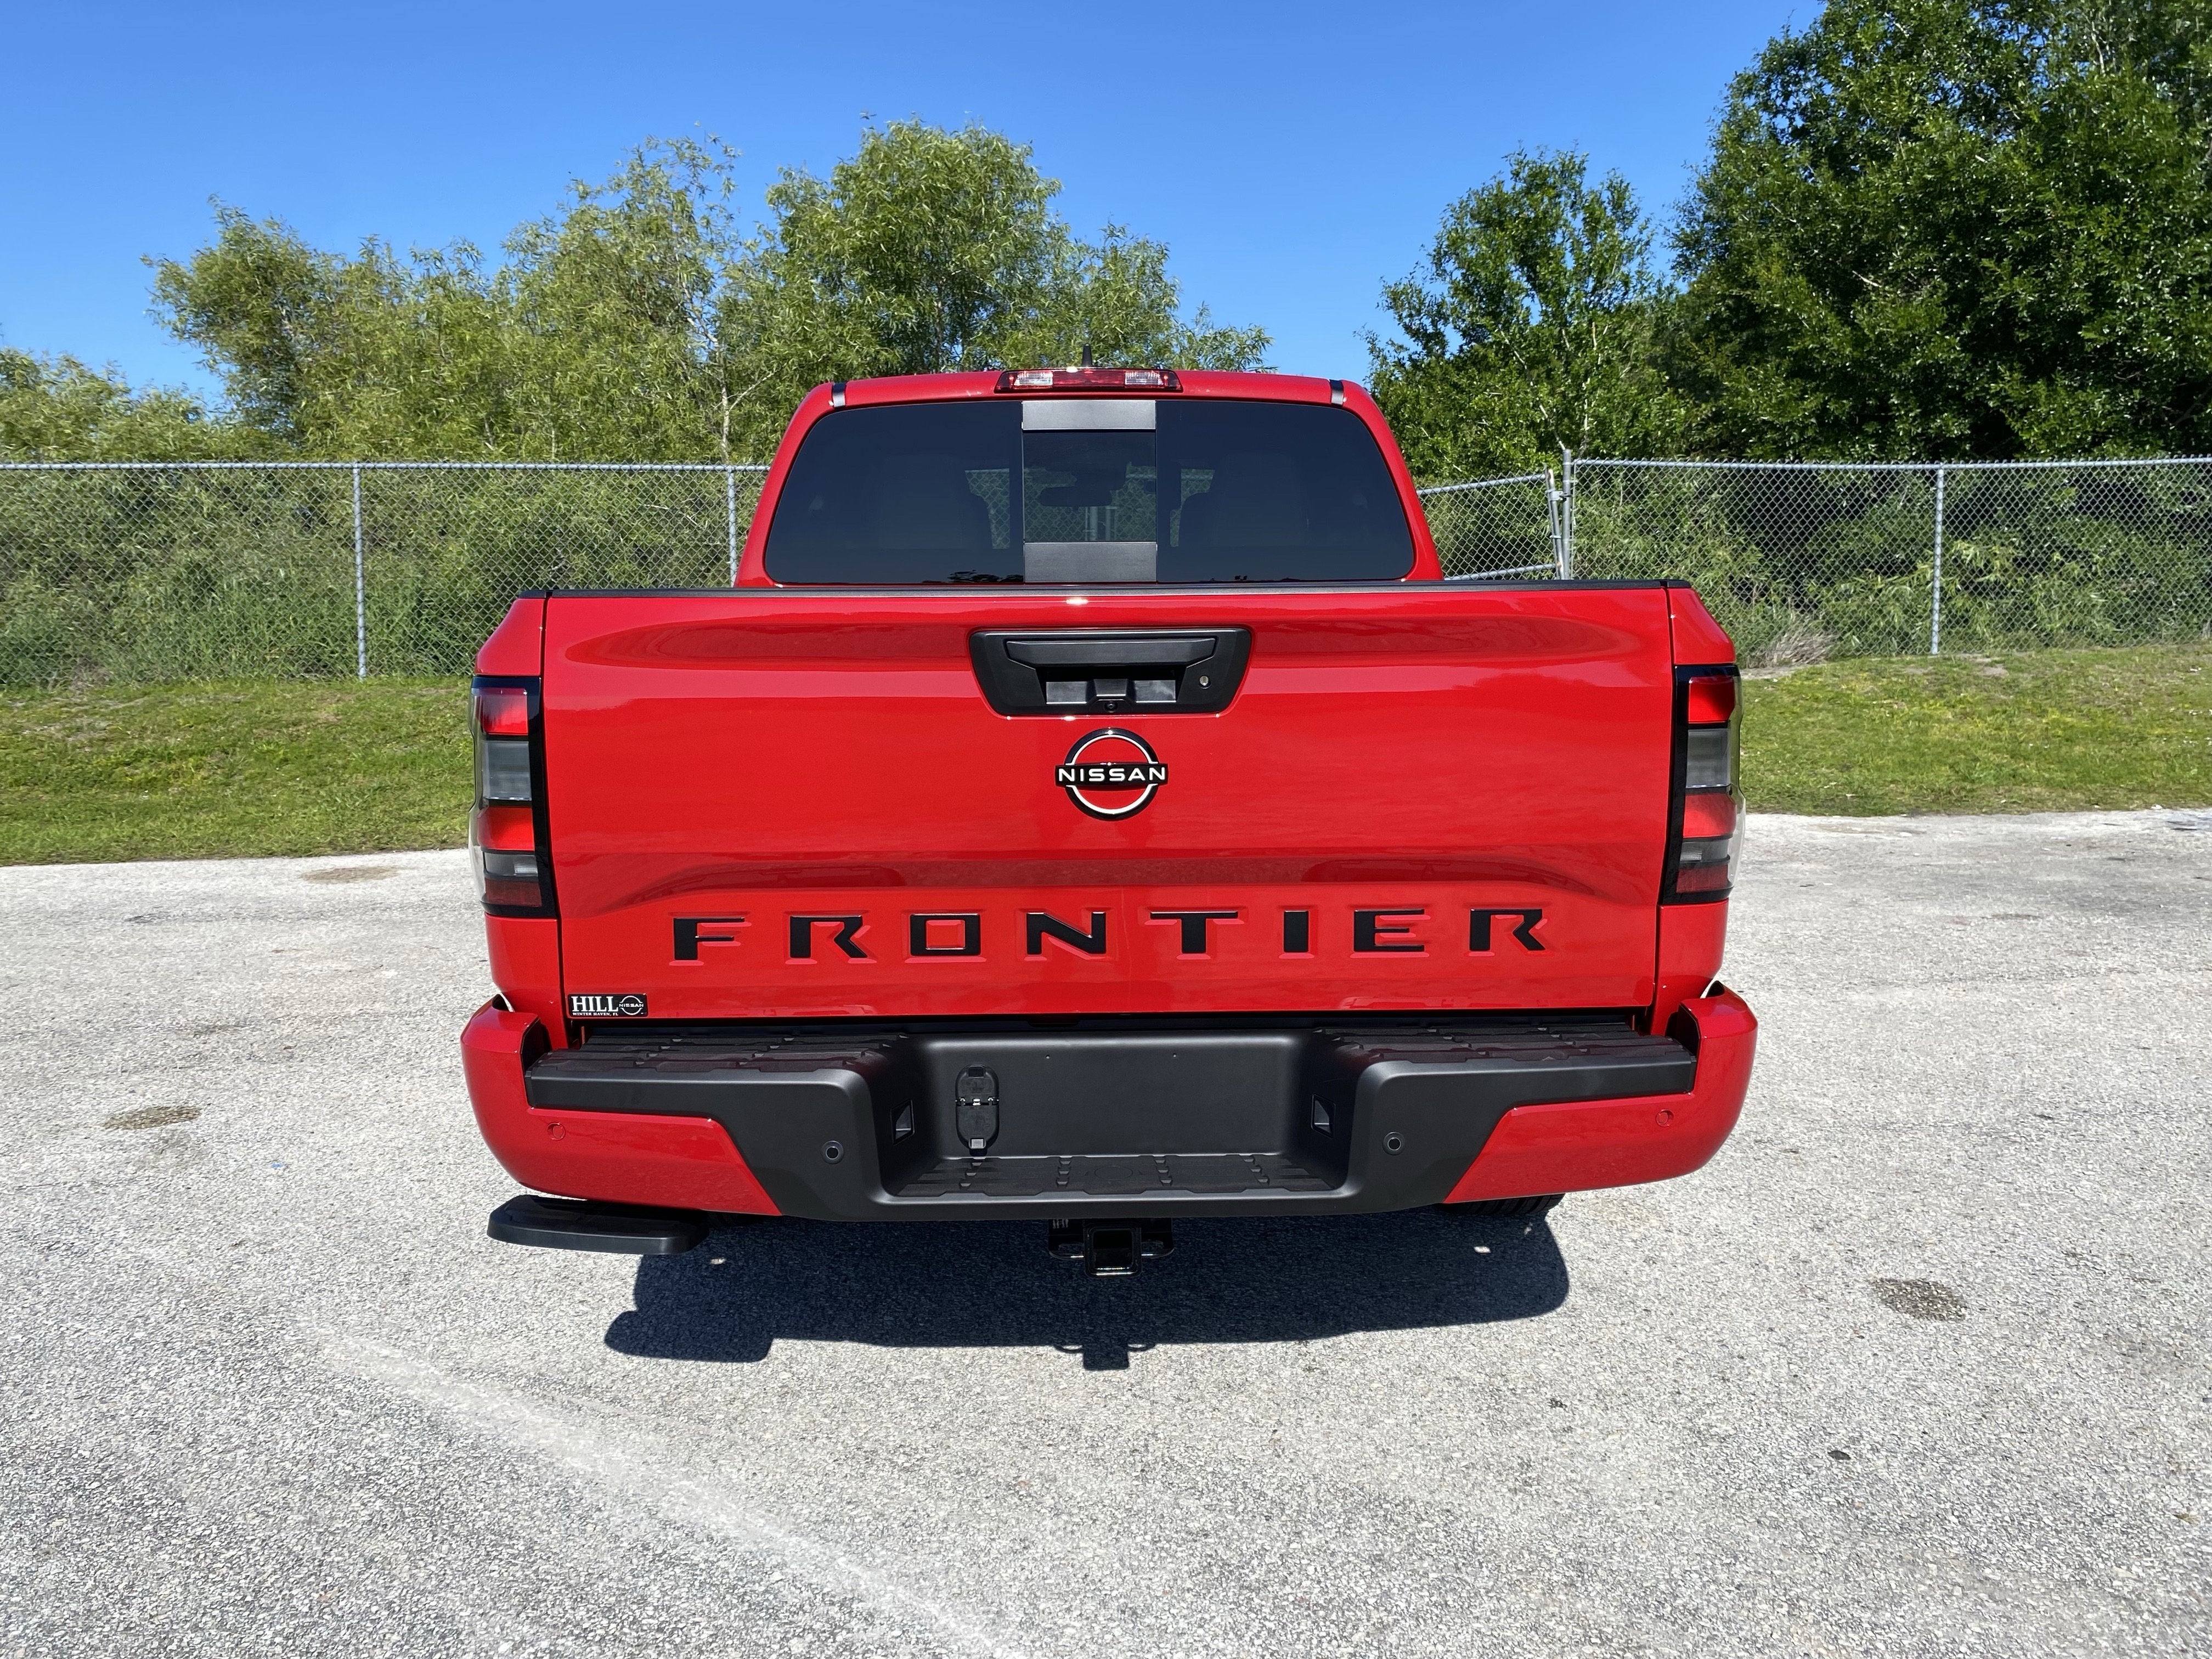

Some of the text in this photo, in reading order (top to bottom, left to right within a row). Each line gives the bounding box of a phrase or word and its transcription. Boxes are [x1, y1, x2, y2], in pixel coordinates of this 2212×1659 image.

[1058, 767, 1165, 782] NISSAN
[672, 909, 1547, 962] FRONTIER
[571, 996, 619, 1012] HILL
